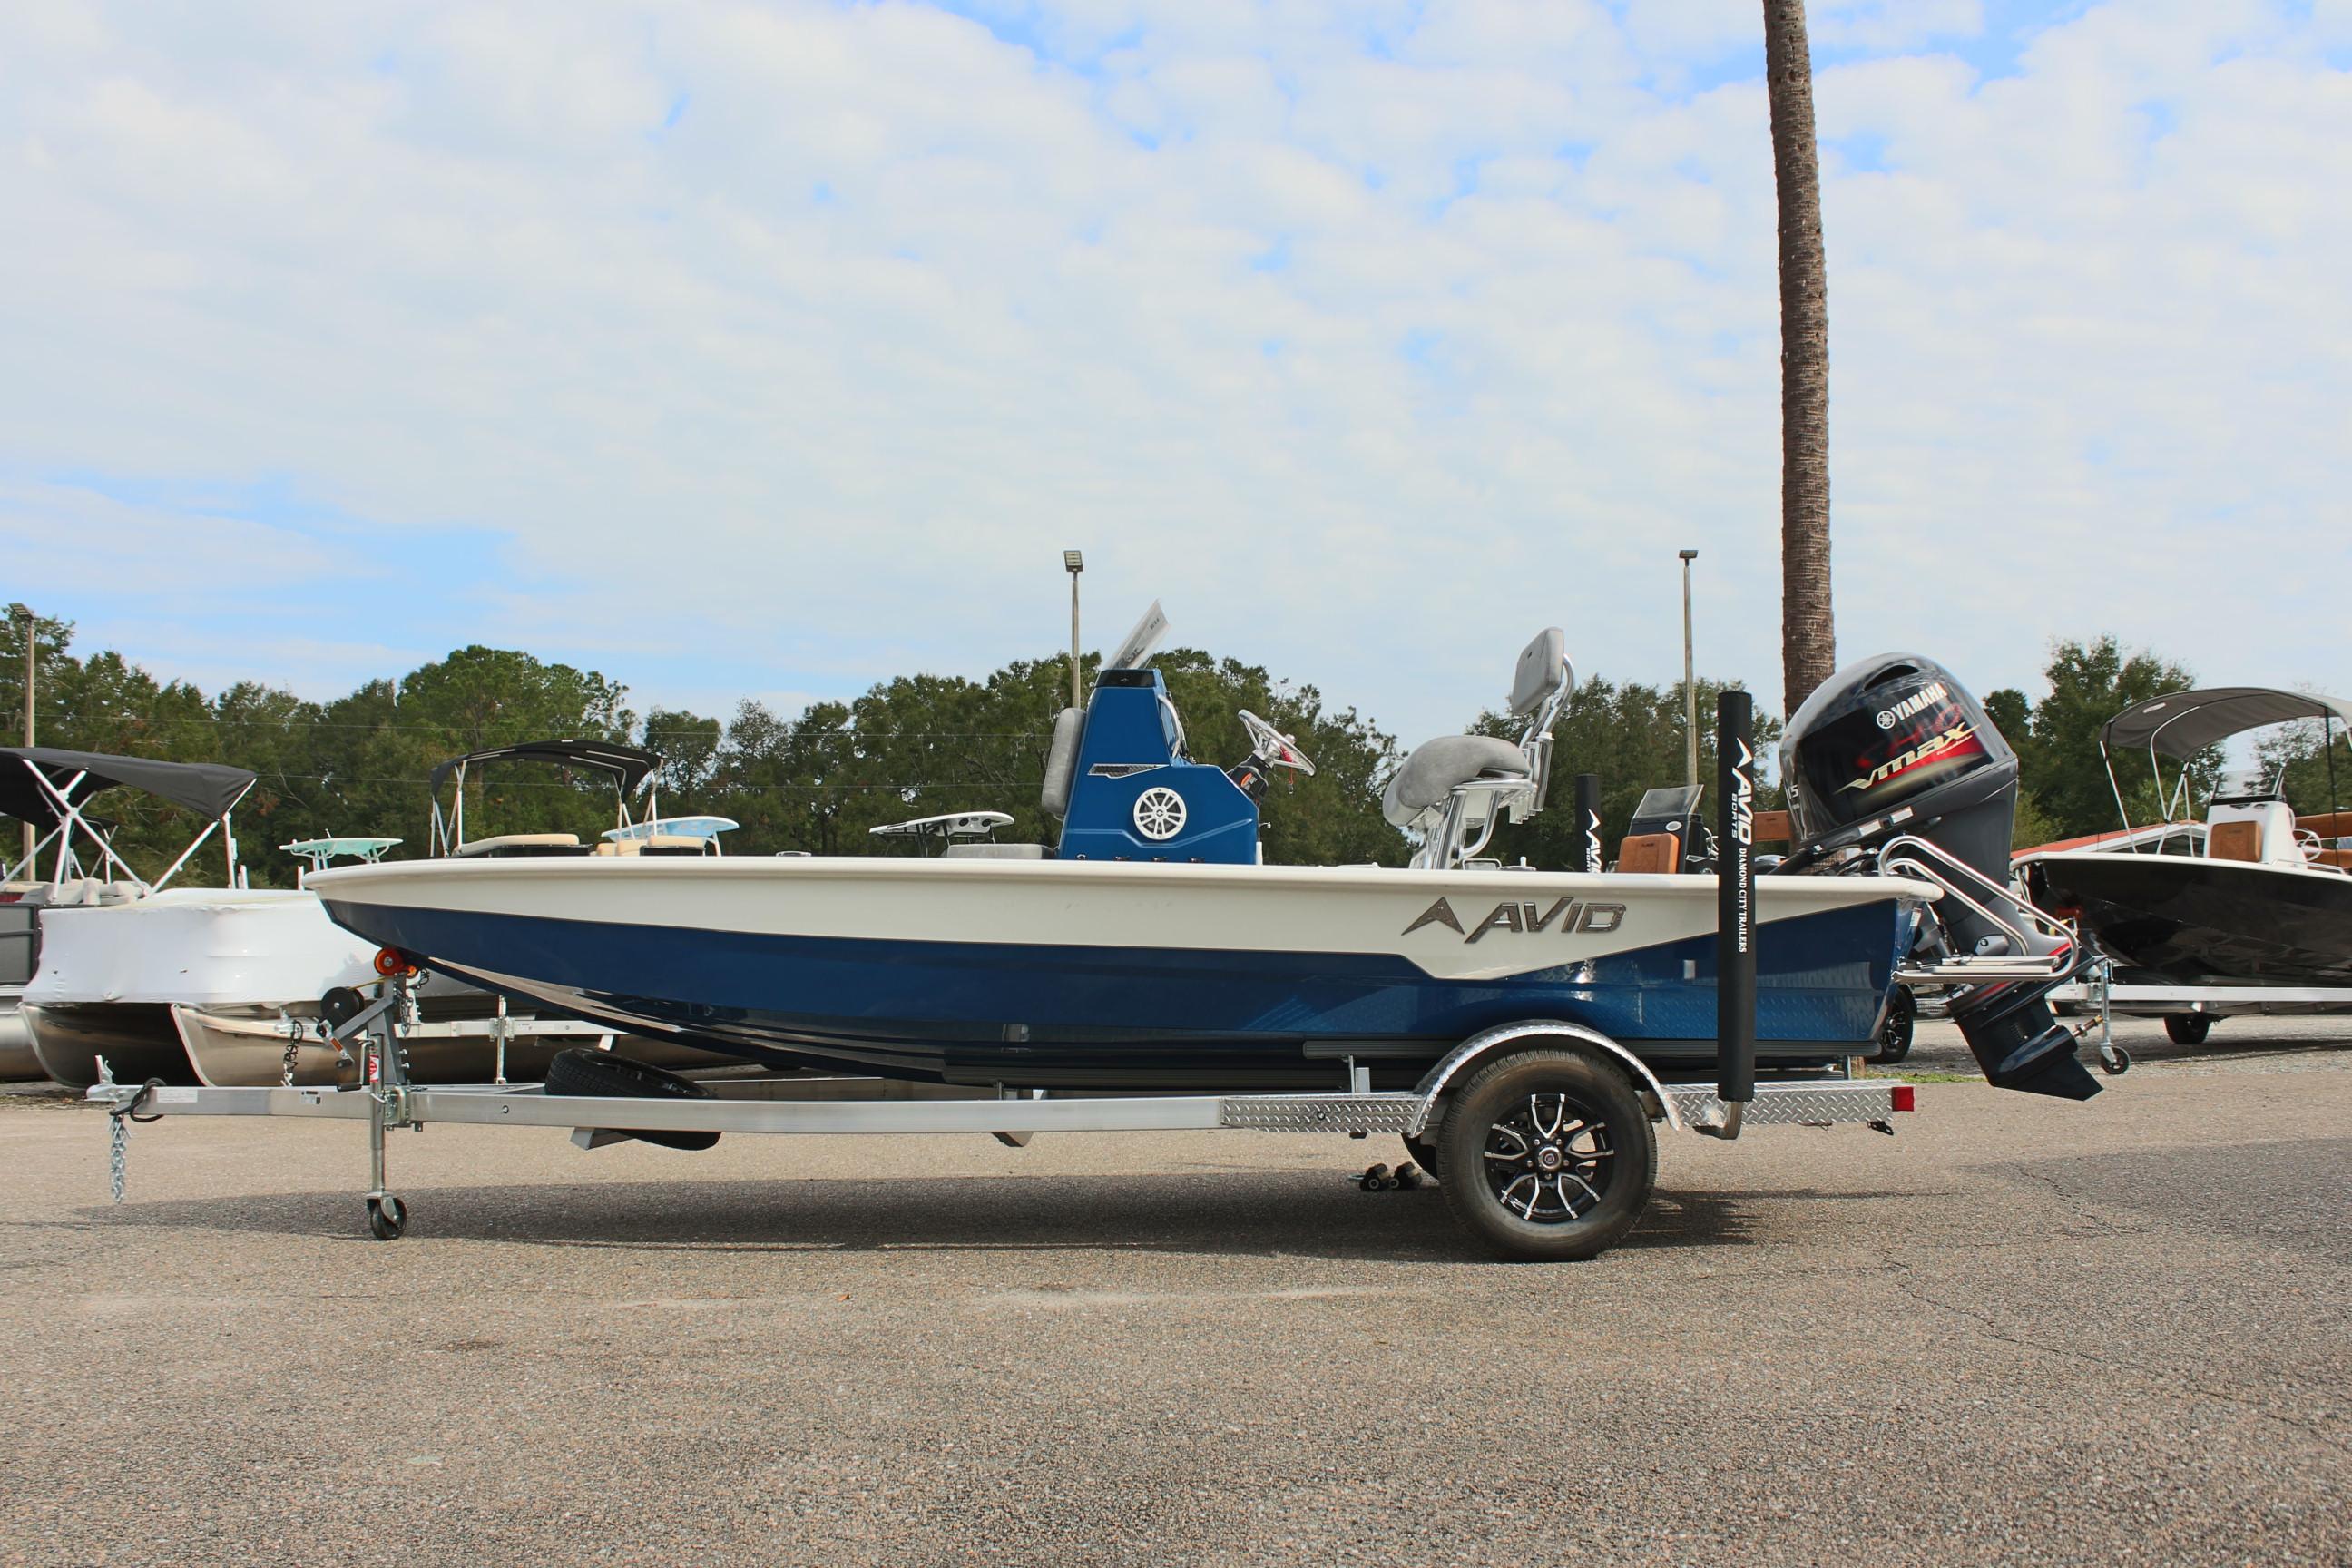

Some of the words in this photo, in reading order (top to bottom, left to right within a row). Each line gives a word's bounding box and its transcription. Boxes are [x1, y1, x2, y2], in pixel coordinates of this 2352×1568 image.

[1891, 682, 1948, 721] YAMAHA
[1732, 767, 1753, 846] AVID
[1585, 829, 1602, 872] AVI
[1739, 848, 1748, 888] DIAMOND
[1465, 897, 1627, 944] AVID
[1739, 889, 1748, 910] CITY
[1739, 910, 1748, 953] TRAILERS
